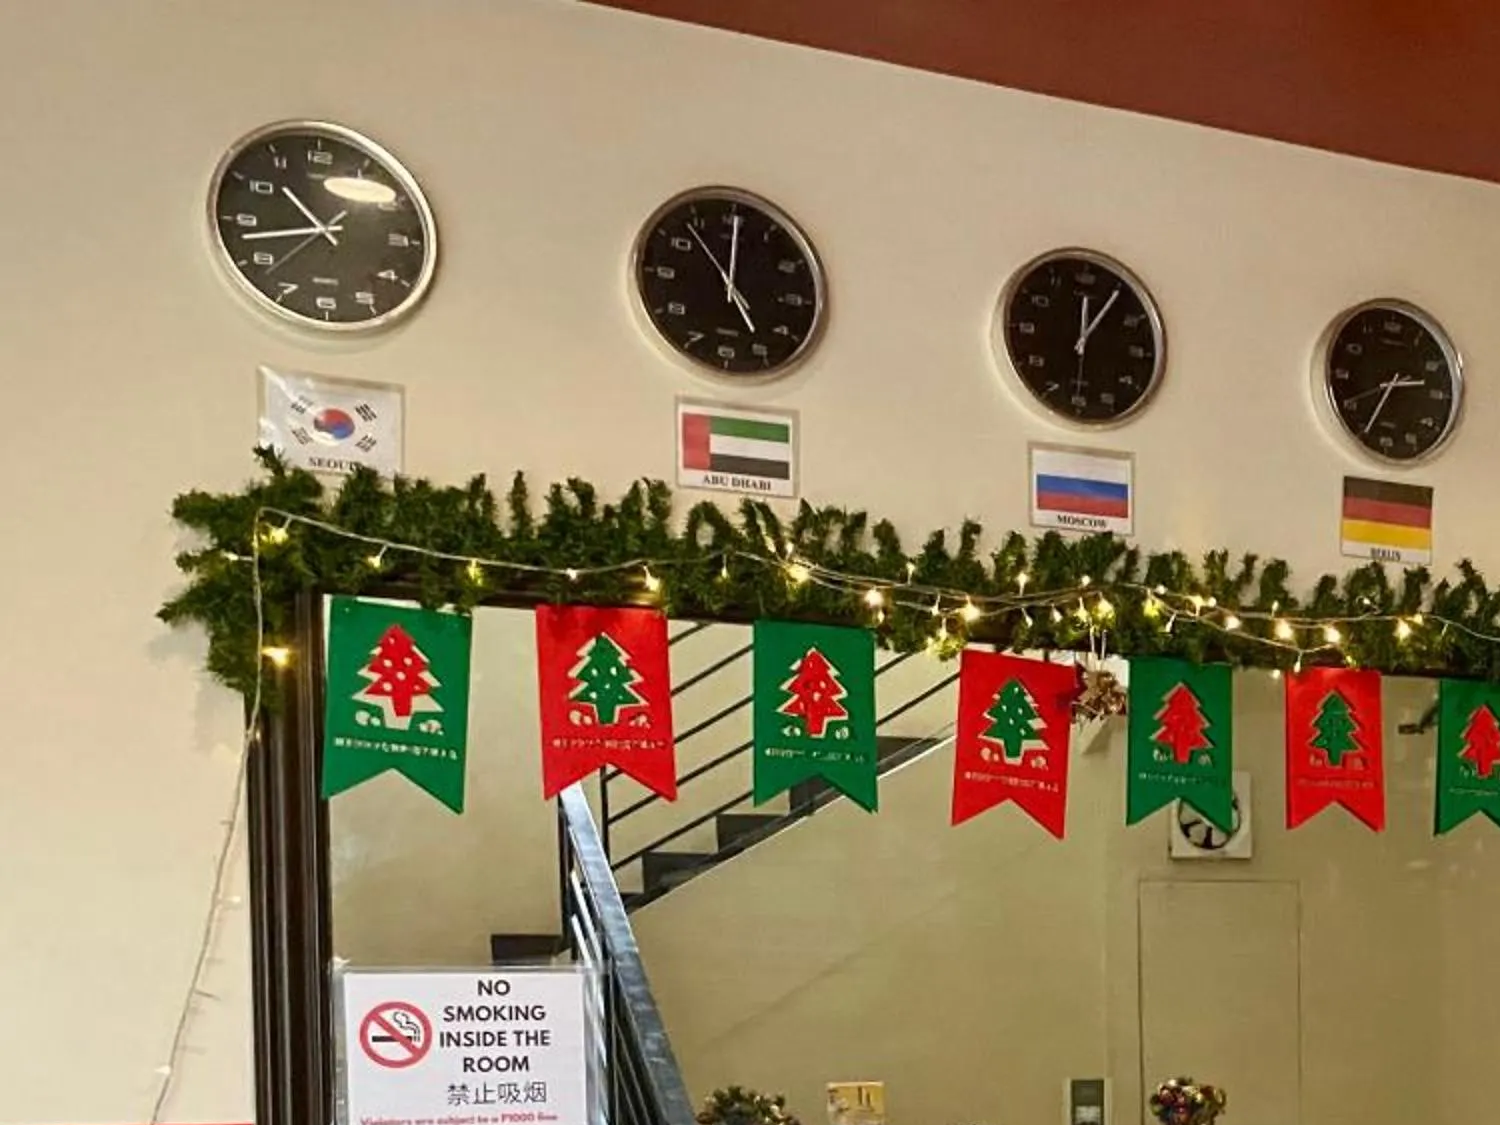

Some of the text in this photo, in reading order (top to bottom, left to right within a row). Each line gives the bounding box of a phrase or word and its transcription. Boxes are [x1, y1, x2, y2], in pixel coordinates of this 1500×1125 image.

[250, 181, 272, 194] 10
[377, 269, 398, 281] 4
[278, 282, 298, 294] 7
[704, 474, 771, 490] ABU DHABI
[478, 980, 510, 996] NO
[443, 1005, 546, 1022] SMOKING
[440, 1030, 551, 1048] INSIDE THE
[463, 1056, 530, 1072] ROOM
[448, 1081, 547, 1106] 禁止吸烟
[415, 1118, 434, 1125] are
[478, 1115, 488, 1124] to
